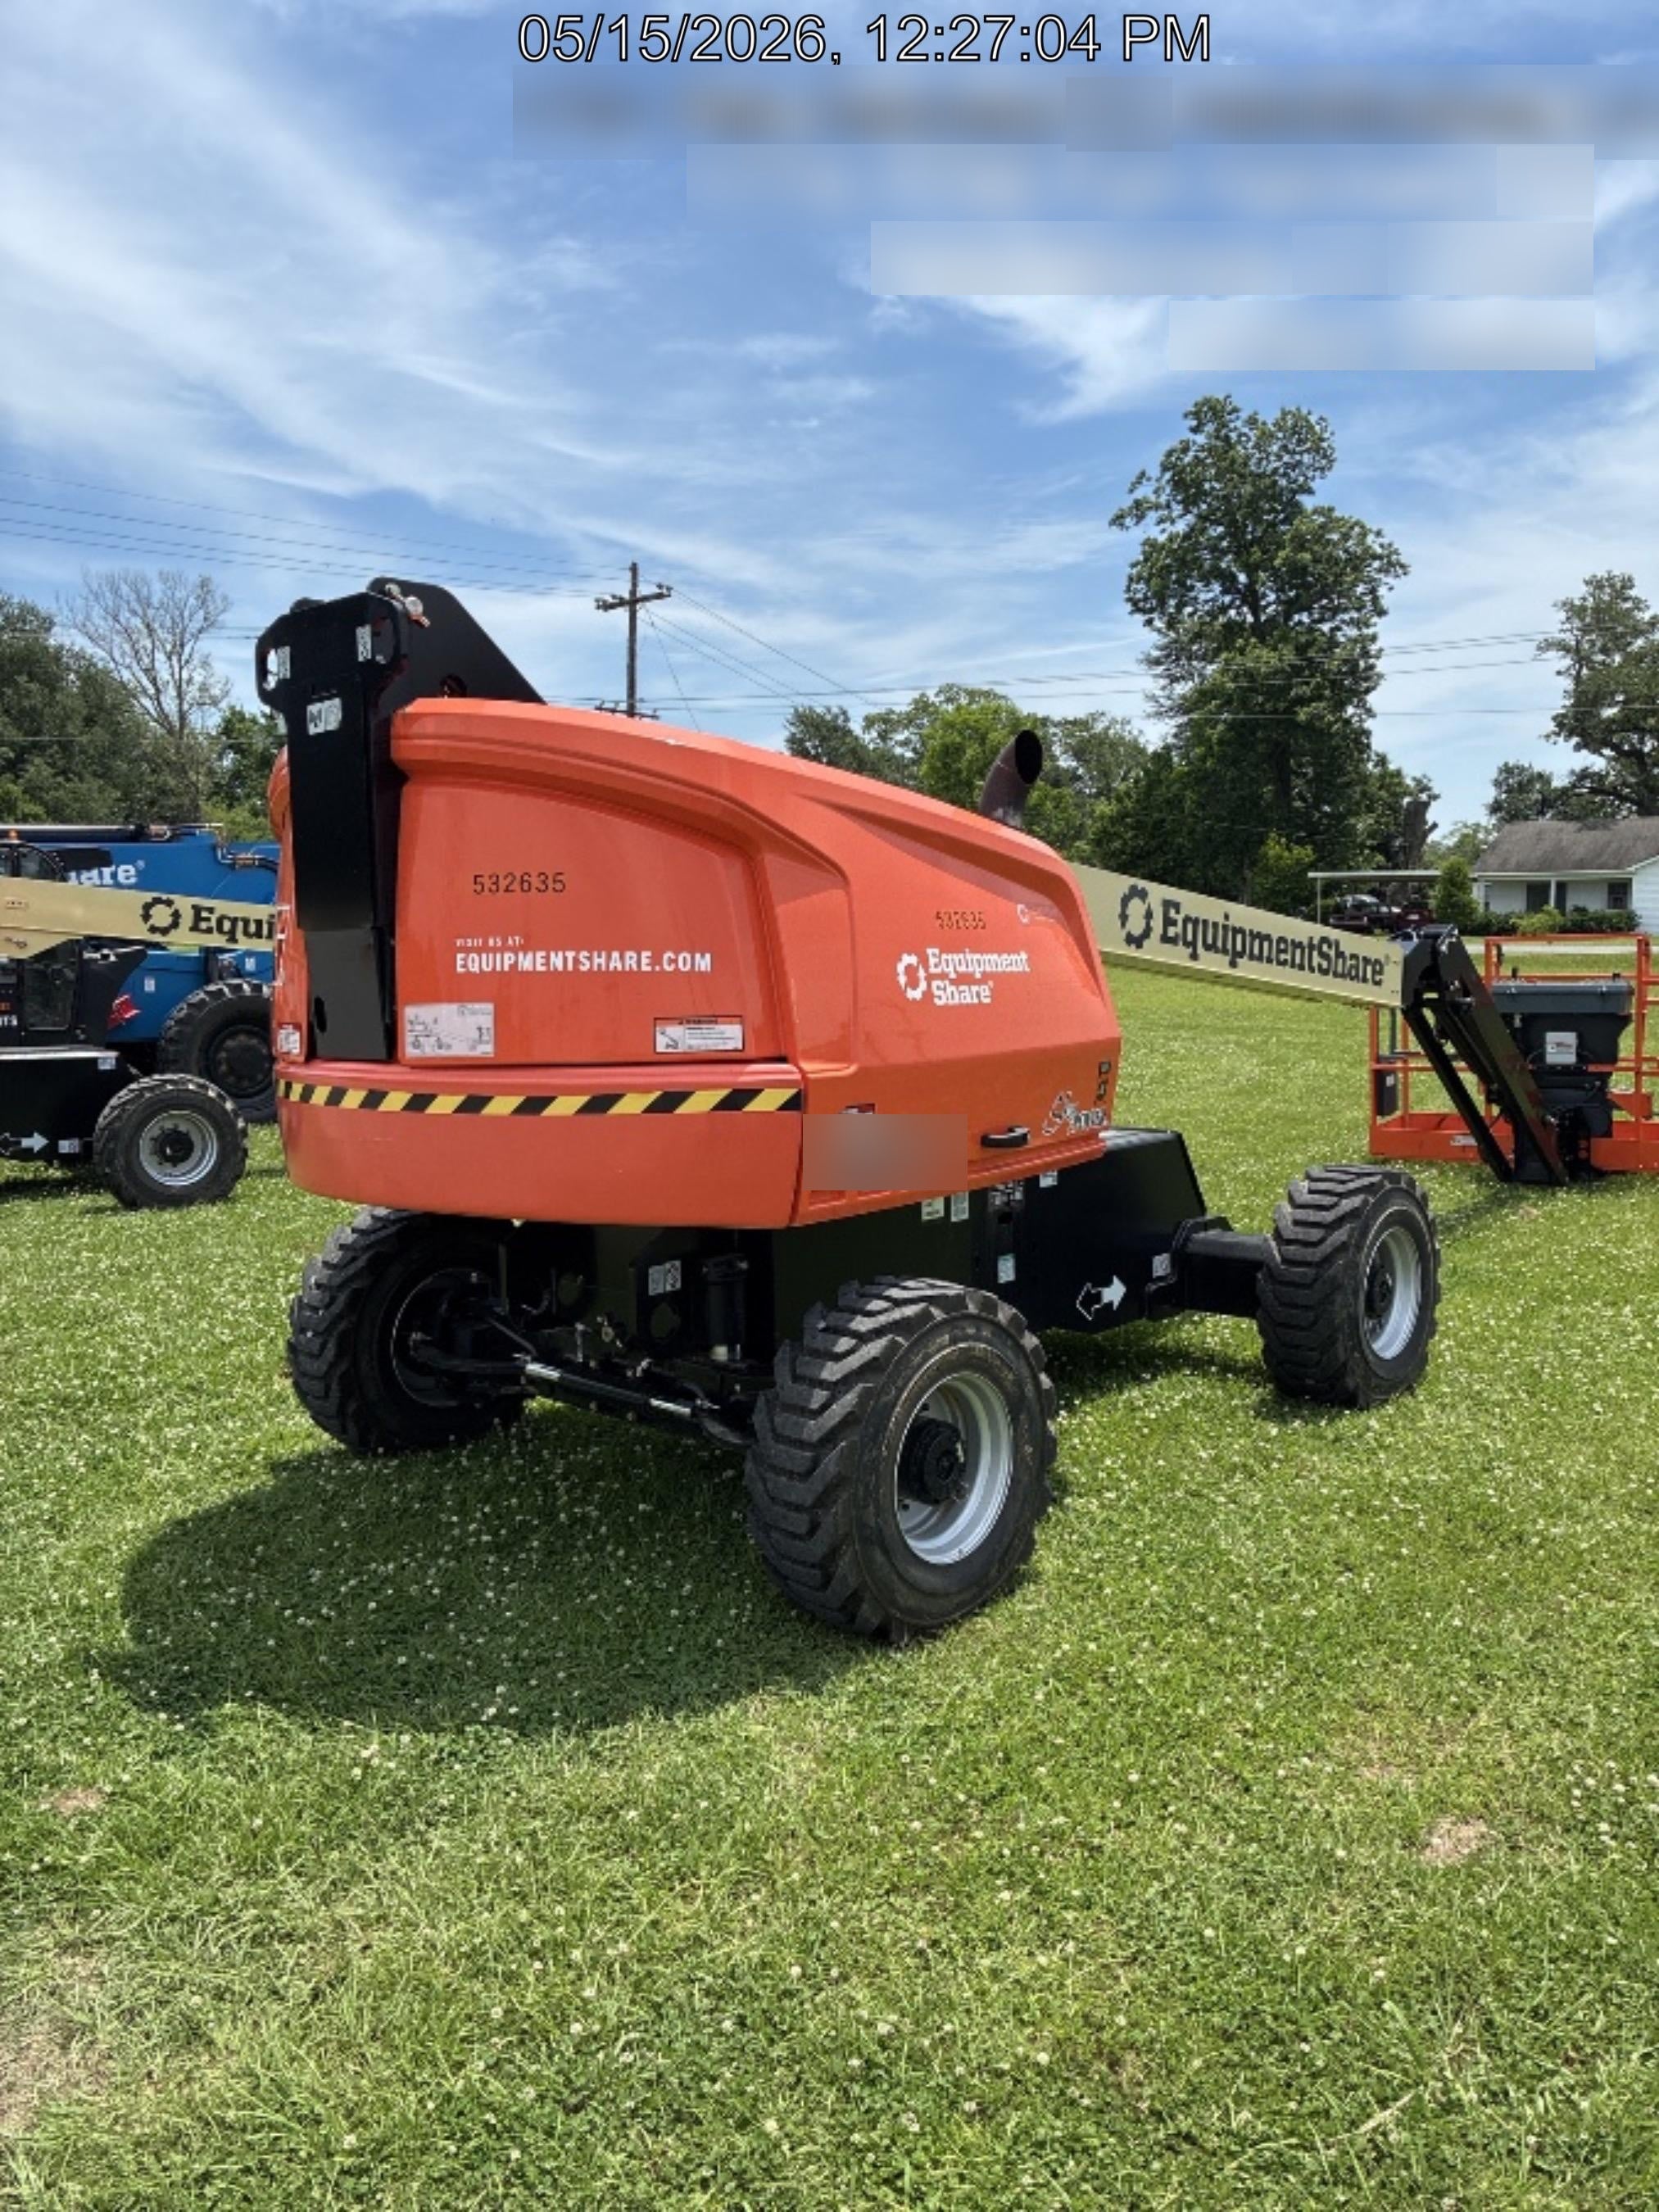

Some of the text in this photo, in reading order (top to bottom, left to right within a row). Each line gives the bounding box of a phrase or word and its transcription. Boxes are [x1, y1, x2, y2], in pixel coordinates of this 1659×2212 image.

[473, 871, 566, 895] 532635
[488, 936, 503, 948] US
[1159, 898, 1386, 986] EquipmentShare
[456, 950, 712, 974] EQUIPMENTSHARE.COM
[926, 947, 1031, 979] Equipment
[931, 980, 992, 1006] Share
